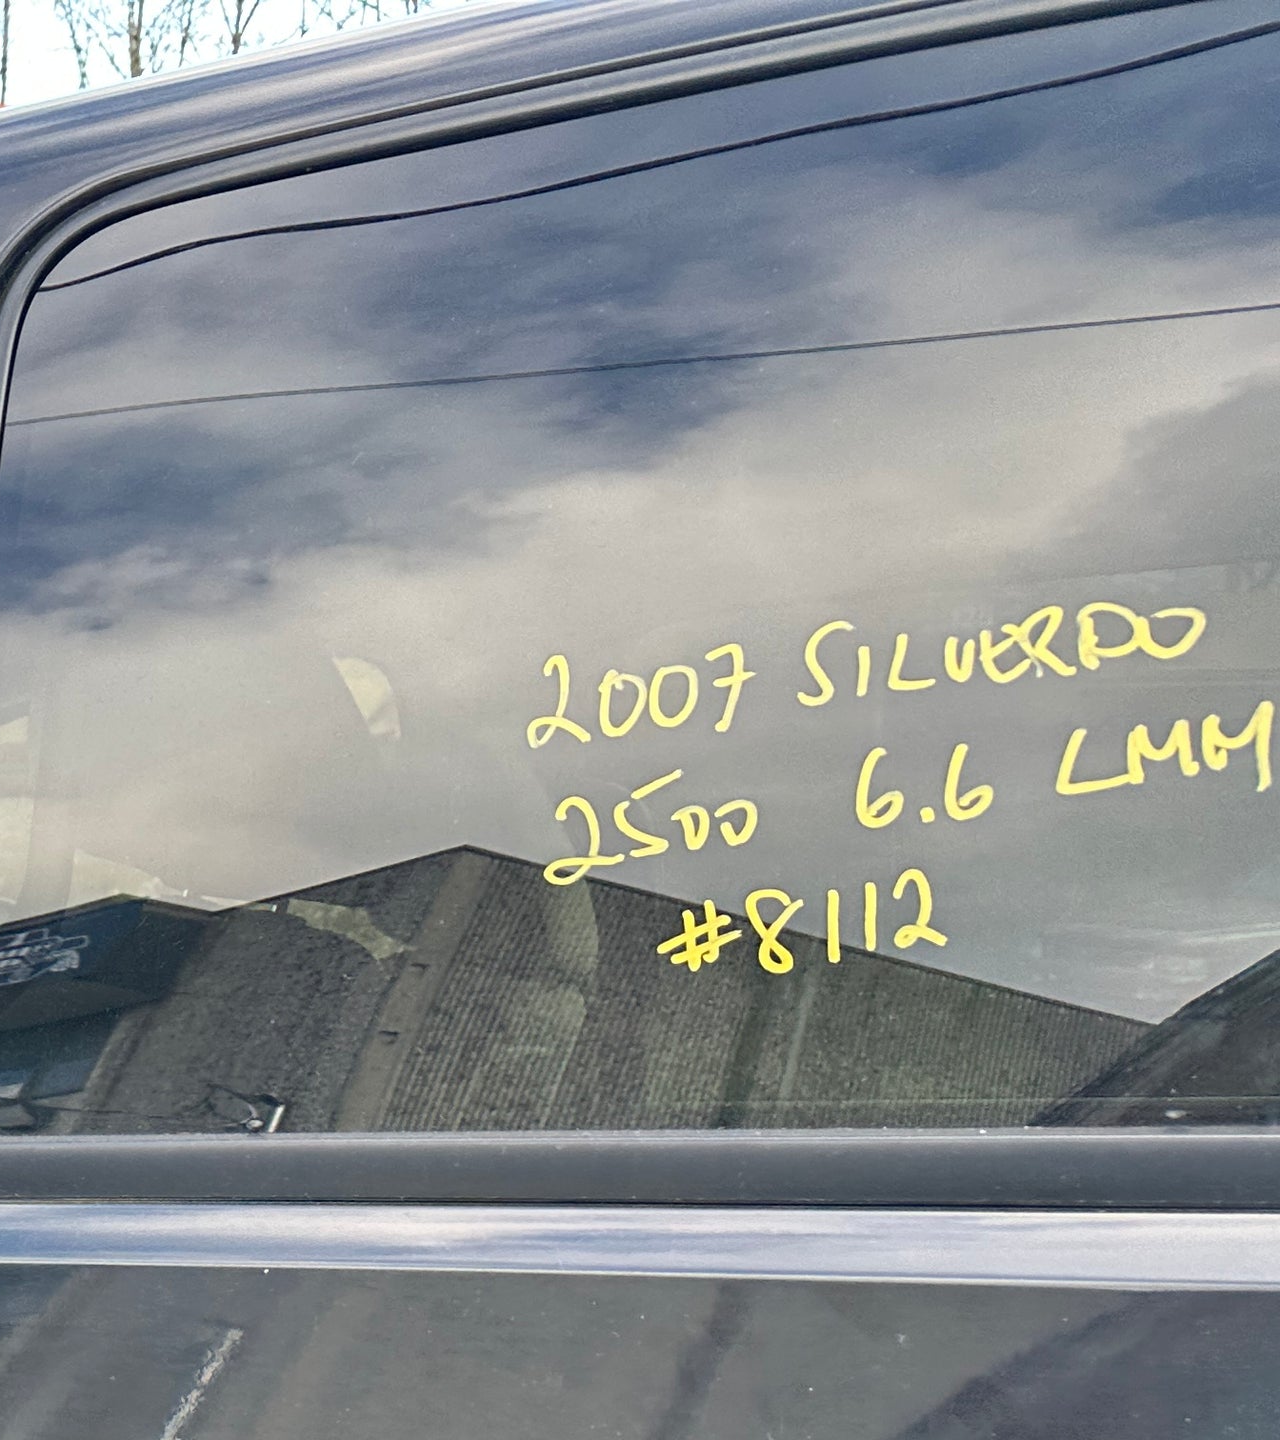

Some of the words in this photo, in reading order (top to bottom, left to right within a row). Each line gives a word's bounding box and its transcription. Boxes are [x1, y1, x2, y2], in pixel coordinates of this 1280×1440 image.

[528, 644, 755, 748] 2007
[542, 768, 758, 886] 2500
[855, 743, 994, 829] 6.6
[1055, 700, 1274, 796] LMM
[657, 868, 948, 975] #8112
